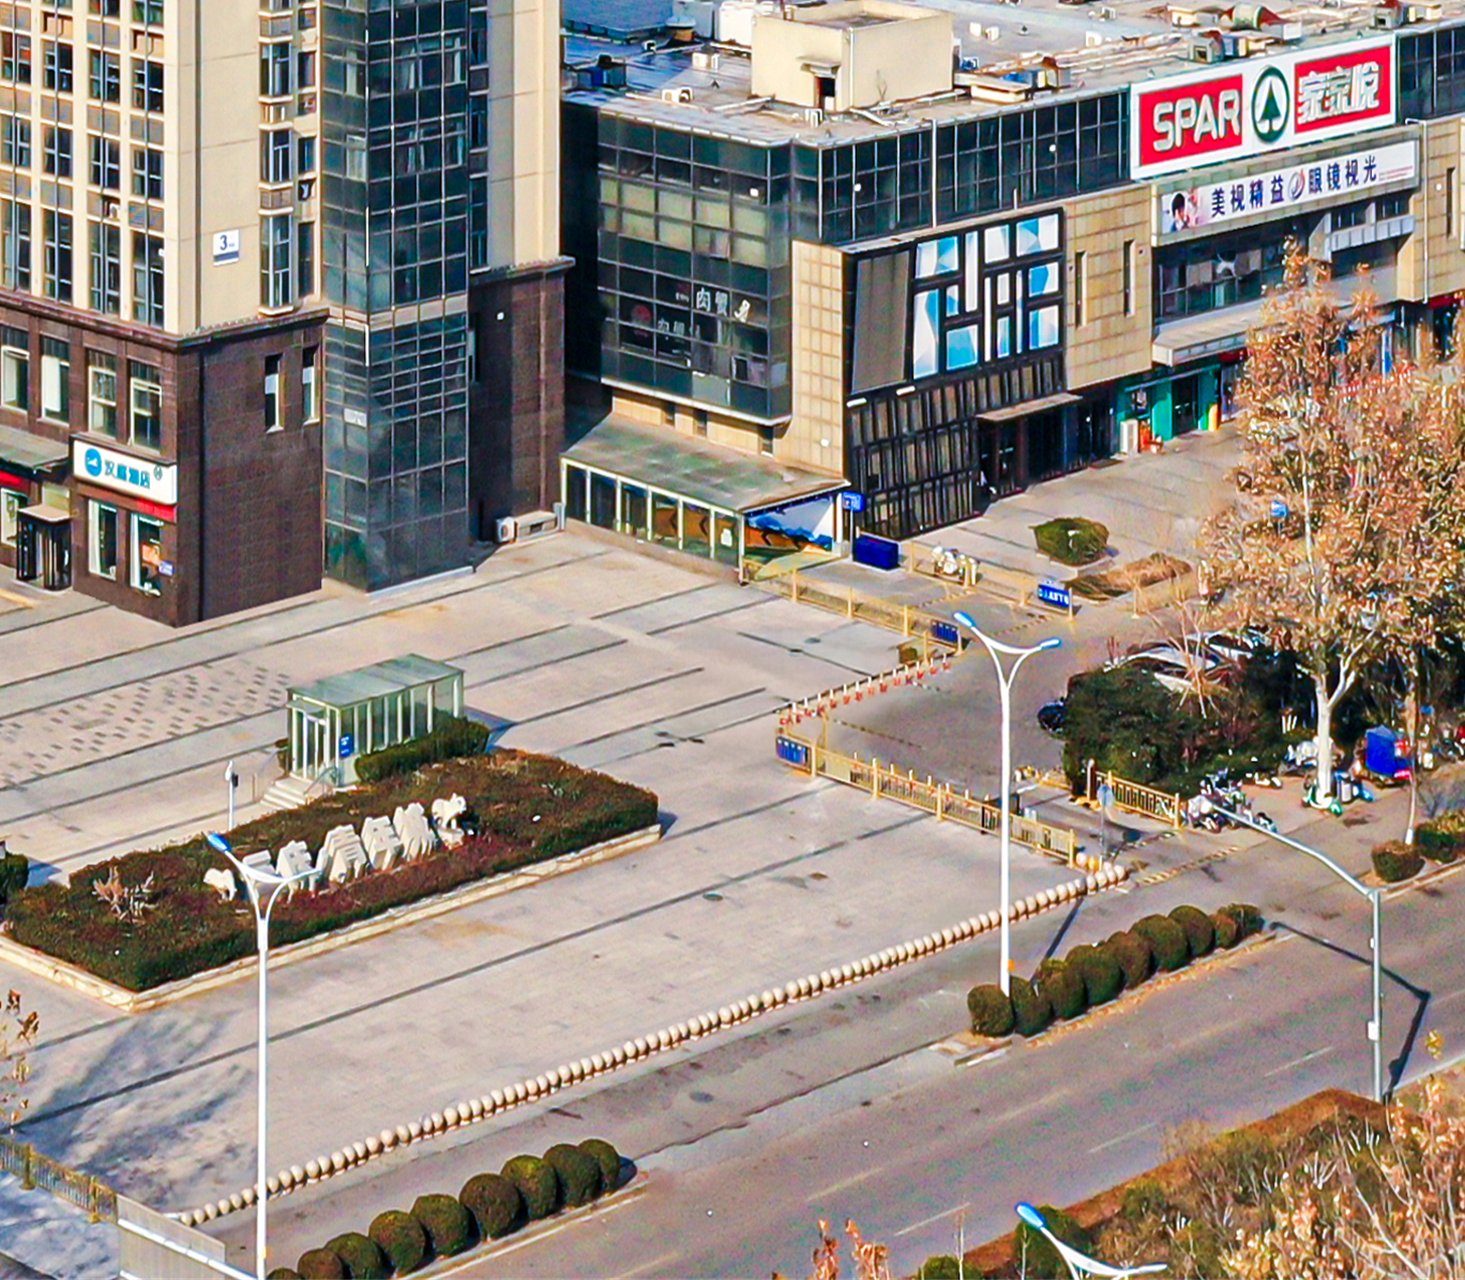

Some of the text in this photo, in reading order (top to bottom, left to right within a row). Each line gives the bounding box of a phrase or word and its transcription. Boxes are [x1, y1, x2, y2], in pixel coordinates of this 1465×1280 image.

[1153, 88, 1241, 153] SPAR
[1297, 61, 1380, 126] 家家悦
[1211, 155, 1378, 218] 美视精益 眼镜视光
